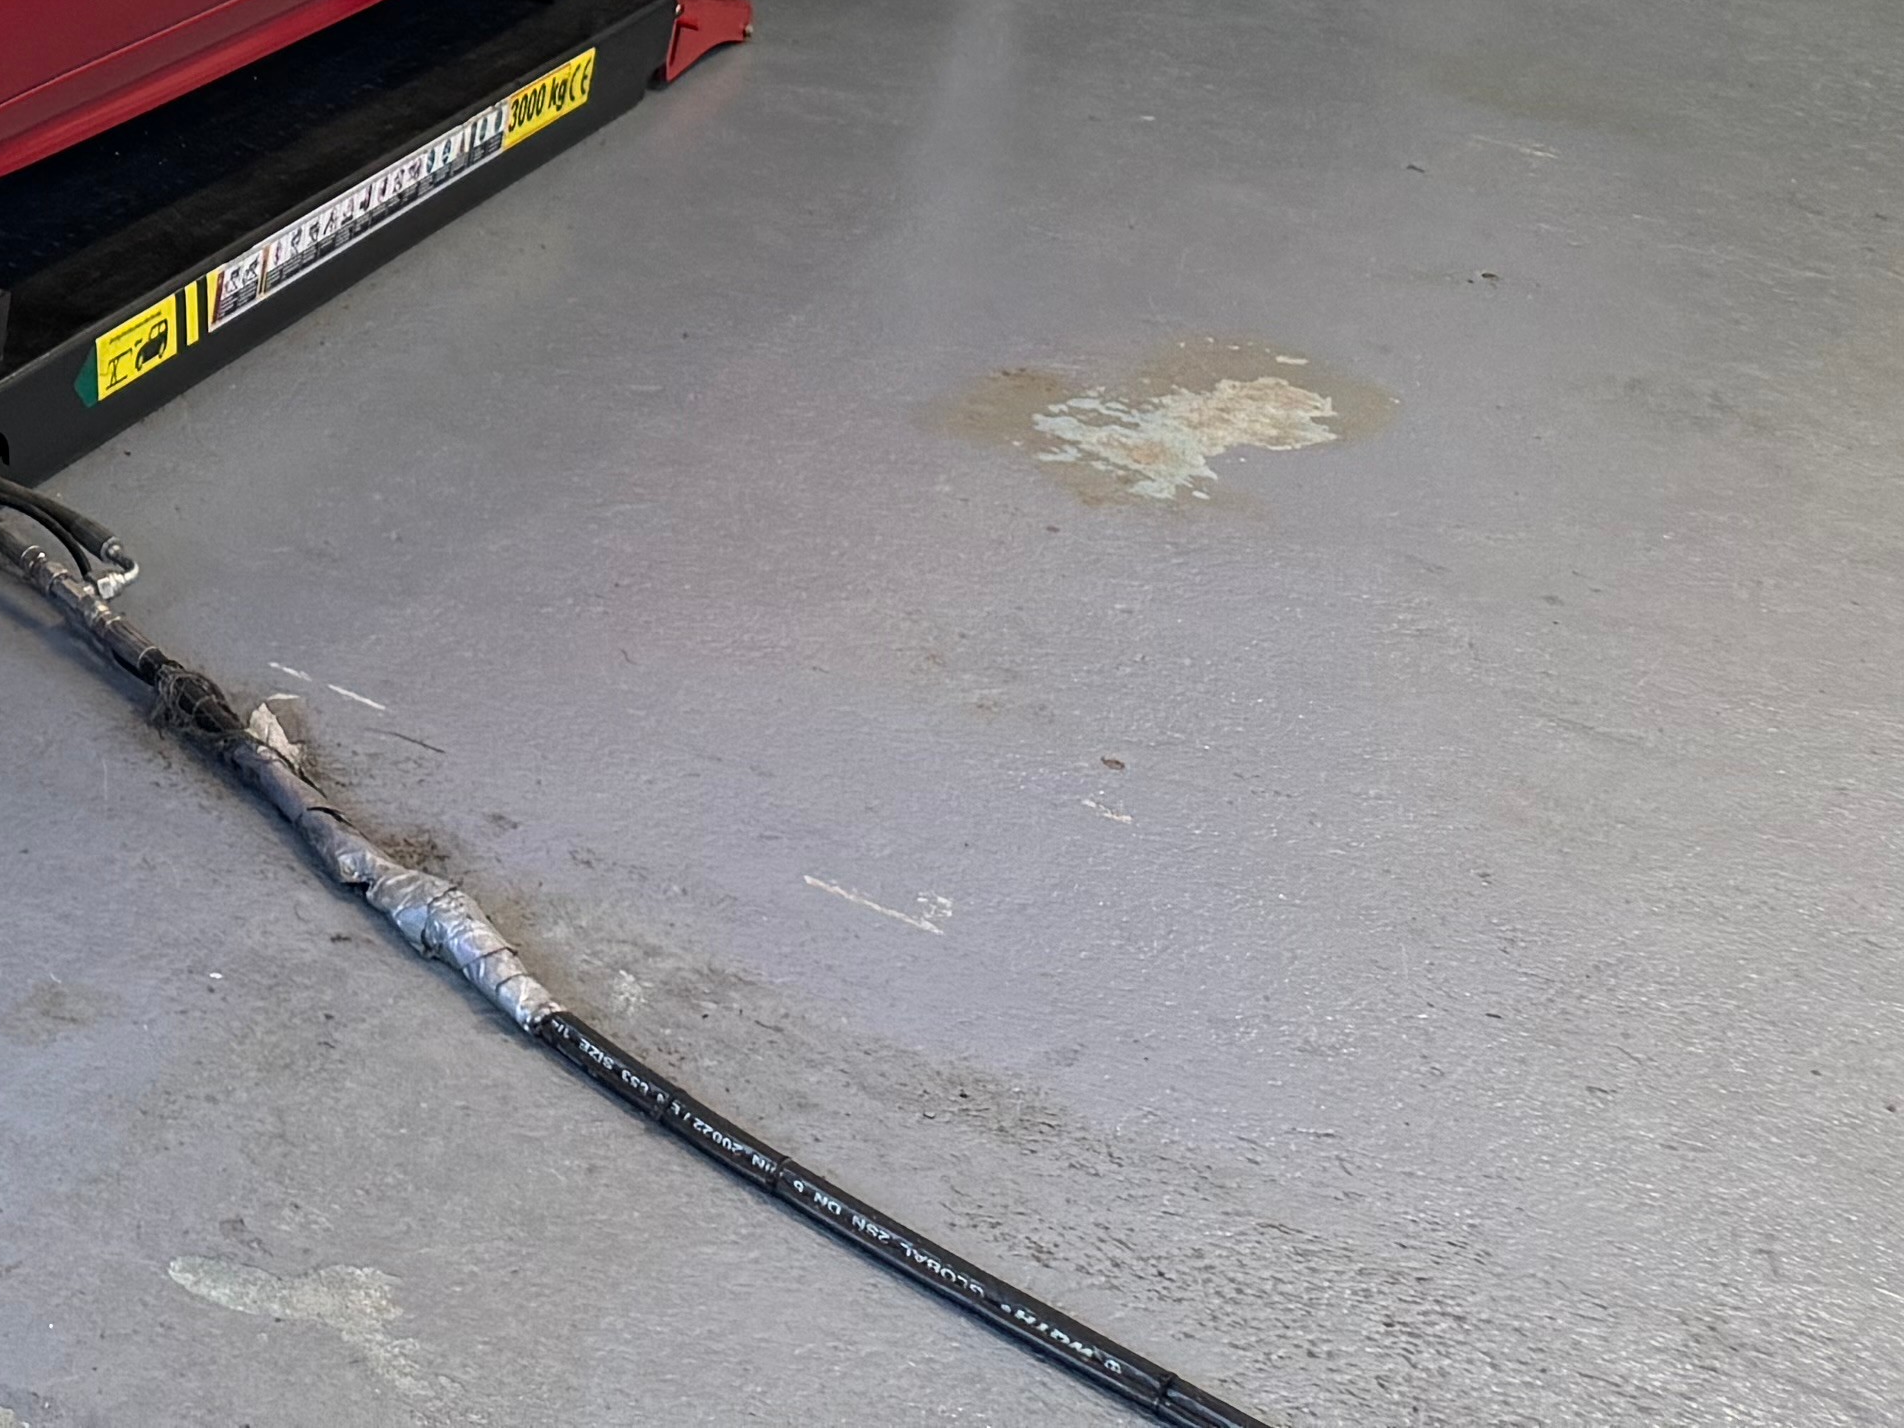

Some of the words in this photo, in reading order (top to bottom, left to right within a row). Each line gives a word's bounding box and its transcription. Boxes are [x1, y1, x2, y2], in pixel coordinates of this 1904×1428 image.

[508, 82, 546, 133] 3000
[547, 76, 569, 112] kg
[578, 1038, 615, 1071] SIZE
[900, 1241, 985, 1298] GLOBAL
